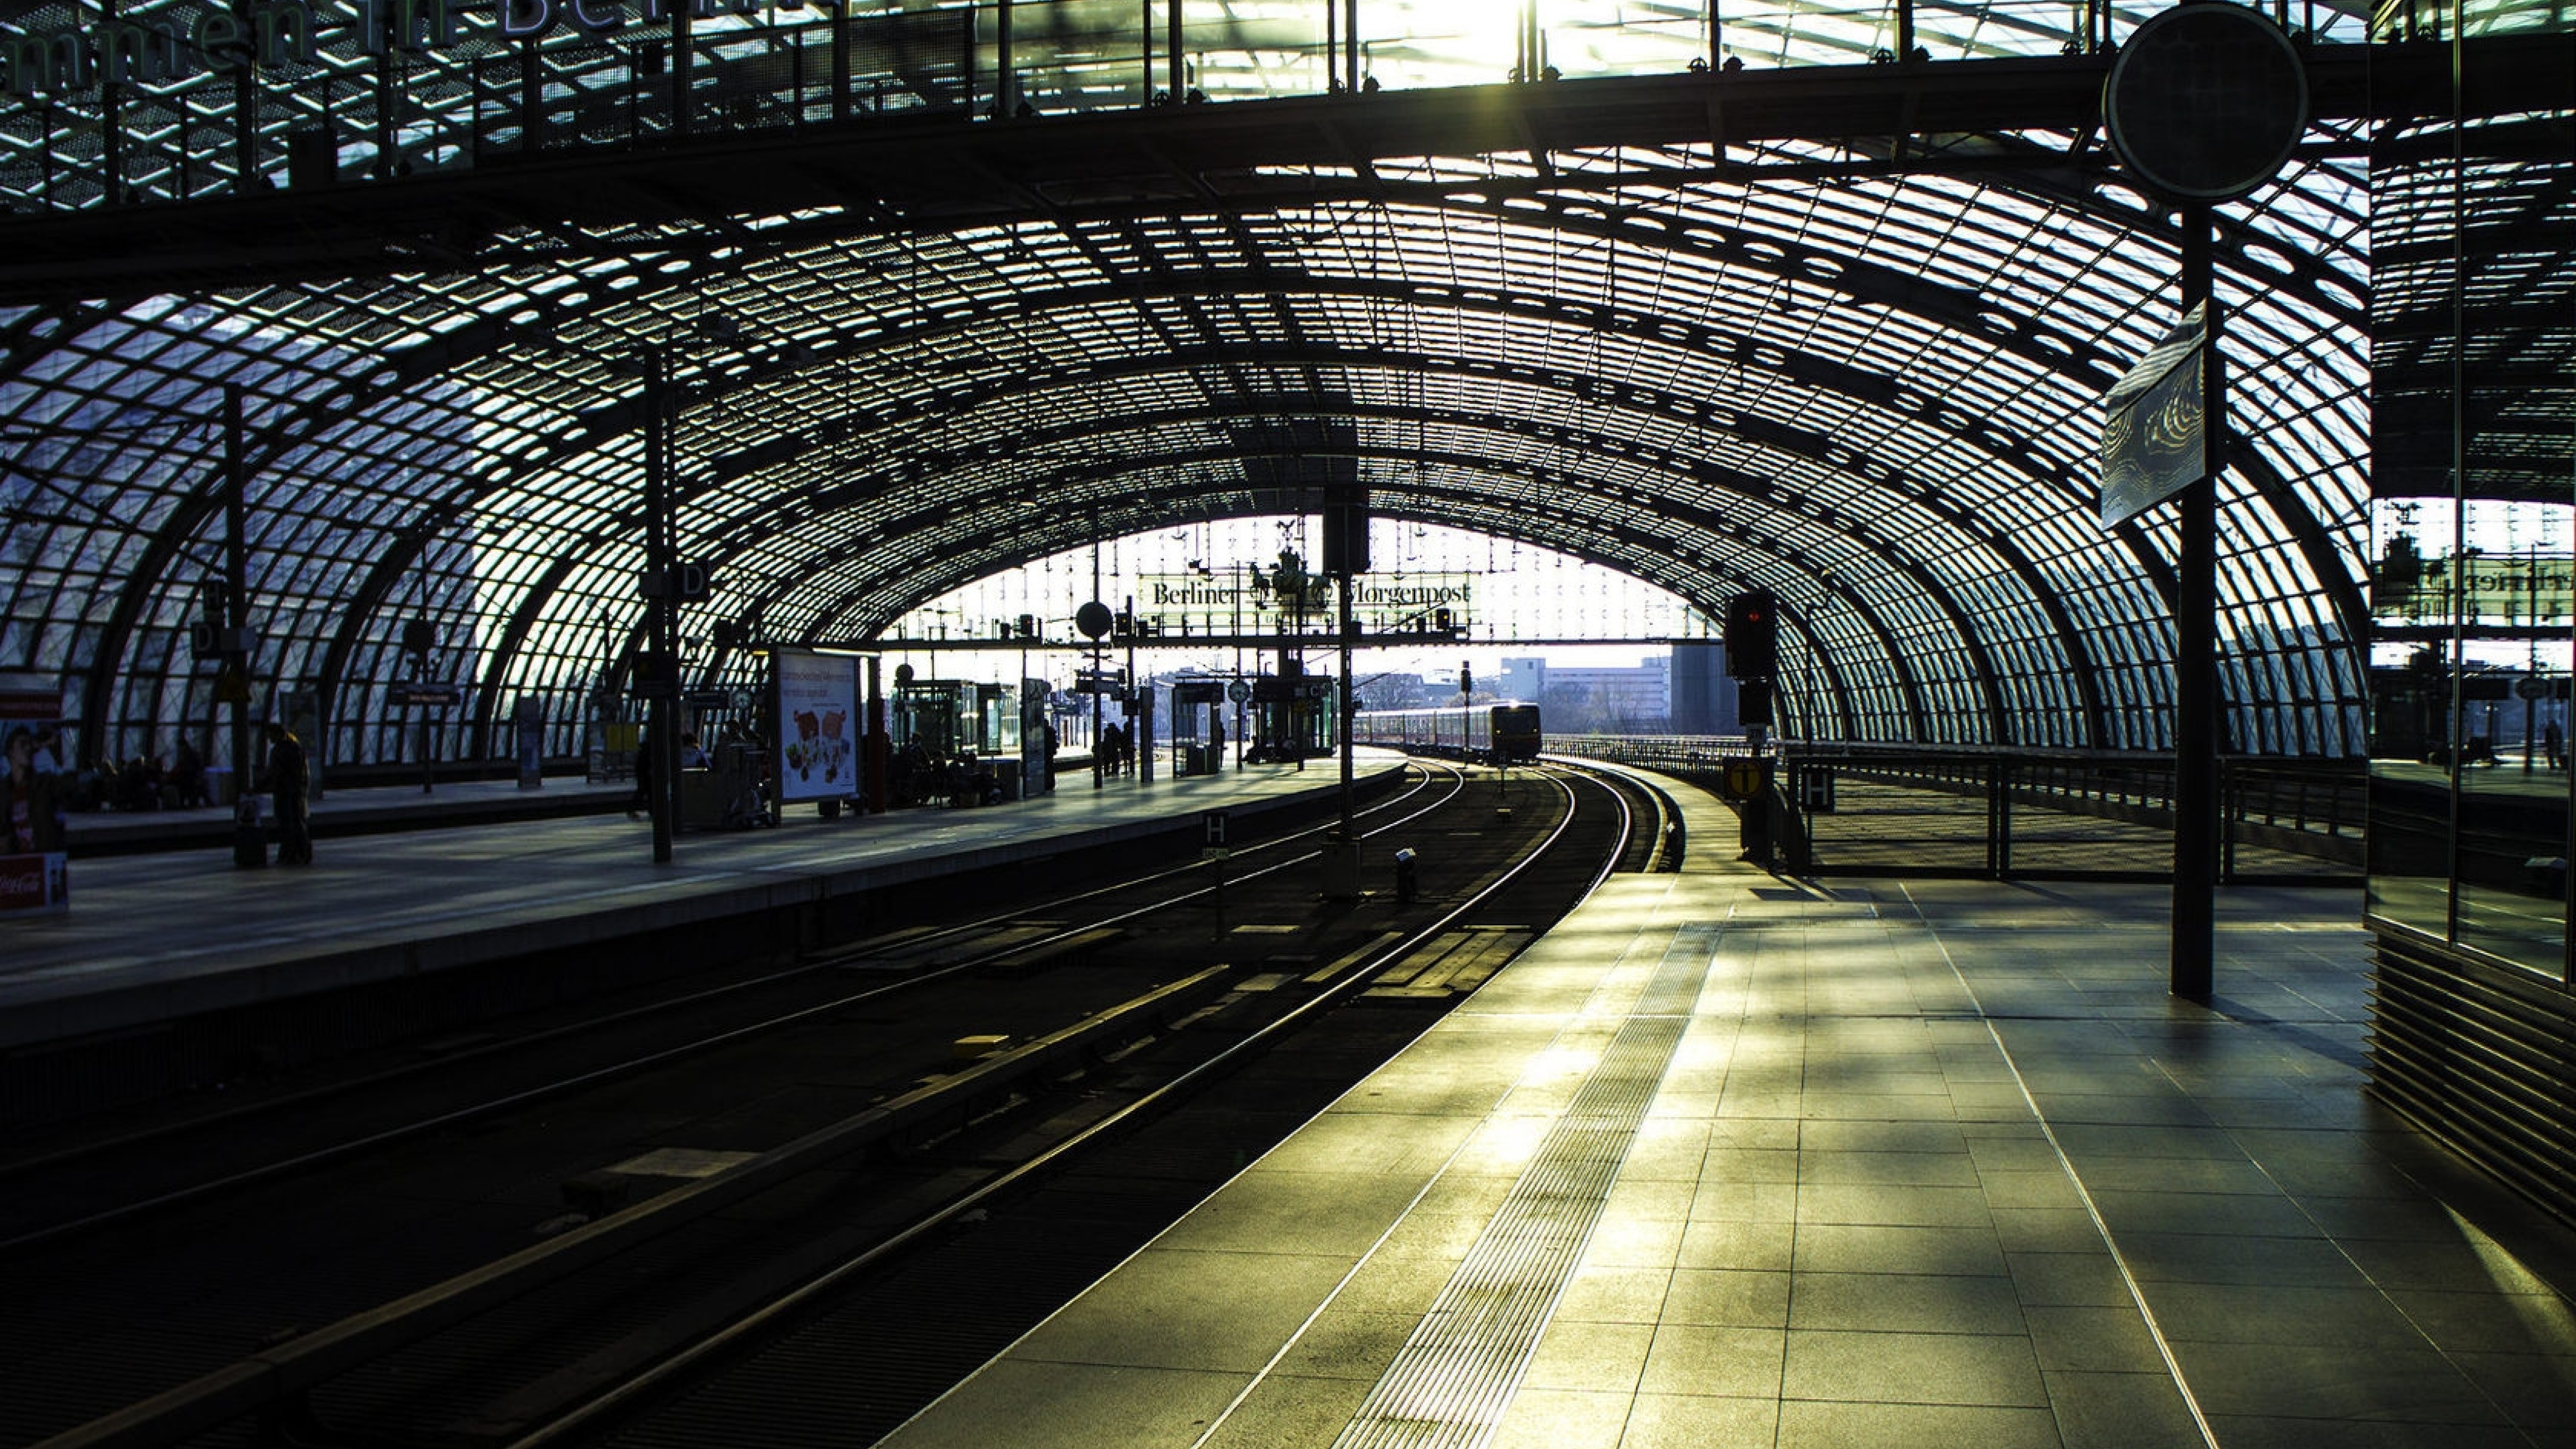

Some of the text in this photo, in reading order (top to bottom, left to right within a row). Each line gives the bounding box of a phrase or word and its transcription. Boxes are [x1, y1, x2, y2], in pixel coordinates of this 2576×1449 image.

[683, 565, 703, 595] D
[1153, 582, 1236, 604] Berliner
[196, 624, 214, 652] D
[1806, 773, 1828, 805] H
[1206, 816, 1224, 843] H
